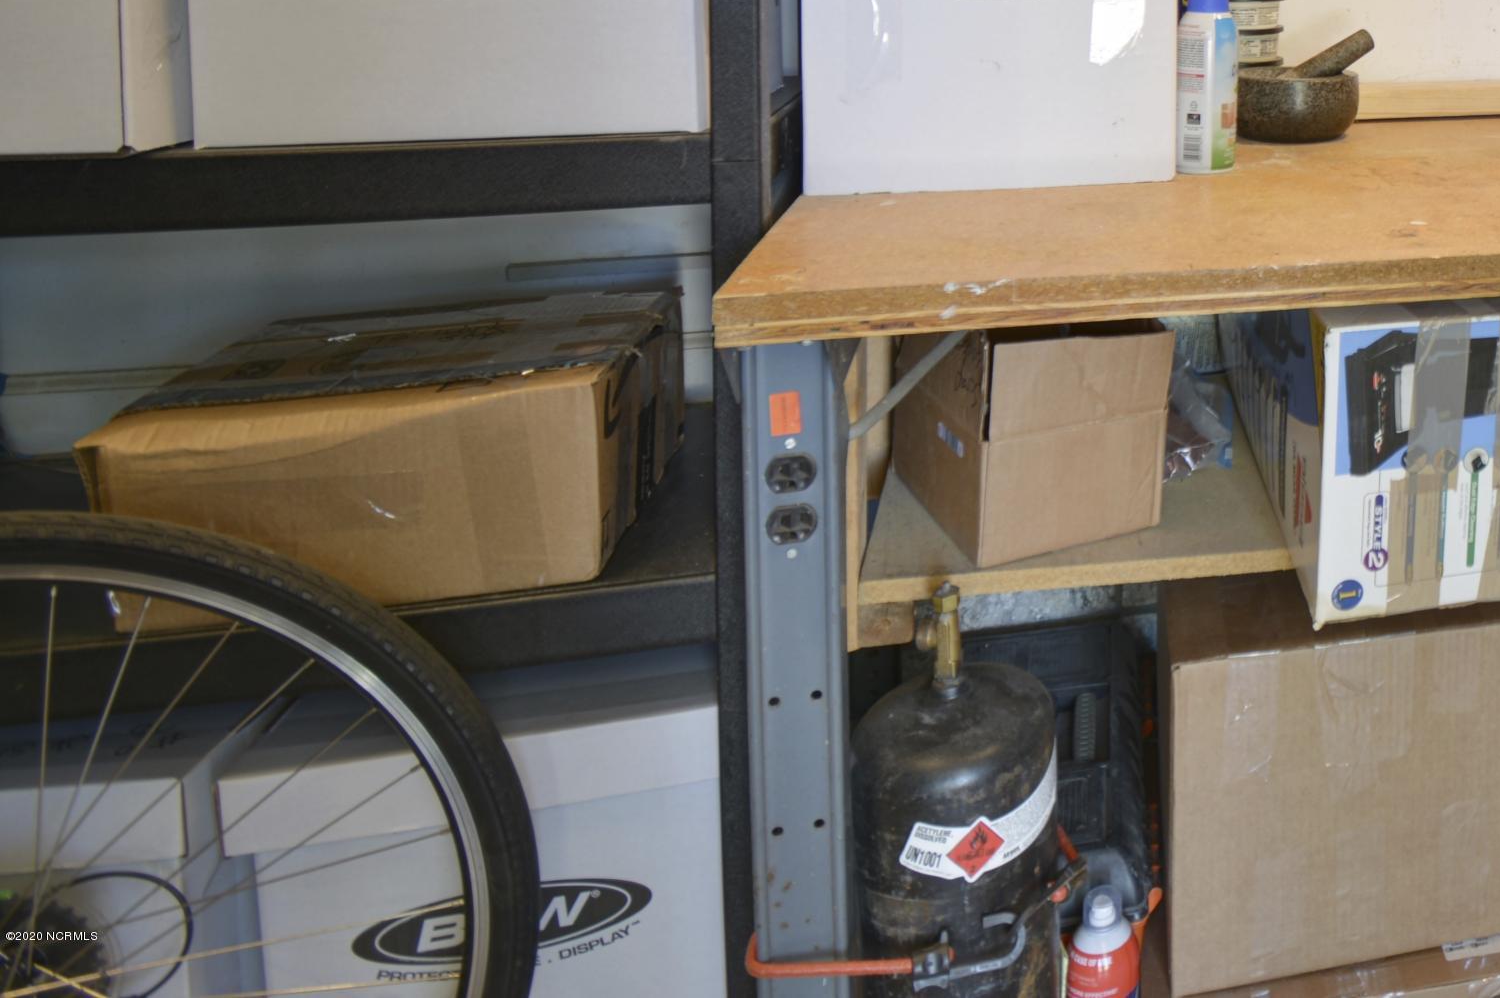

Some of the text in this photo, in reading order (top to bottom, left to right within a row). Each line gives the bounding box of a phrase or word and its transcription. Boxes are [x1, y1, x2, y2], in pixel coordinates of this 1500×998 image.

[1373, 505, 1384, 551] STYLE
[1367, 552, 1385, 569] 2
[905, 845, 942, 869] UN1001
[559, 925, 631, 961] DISPLAY
